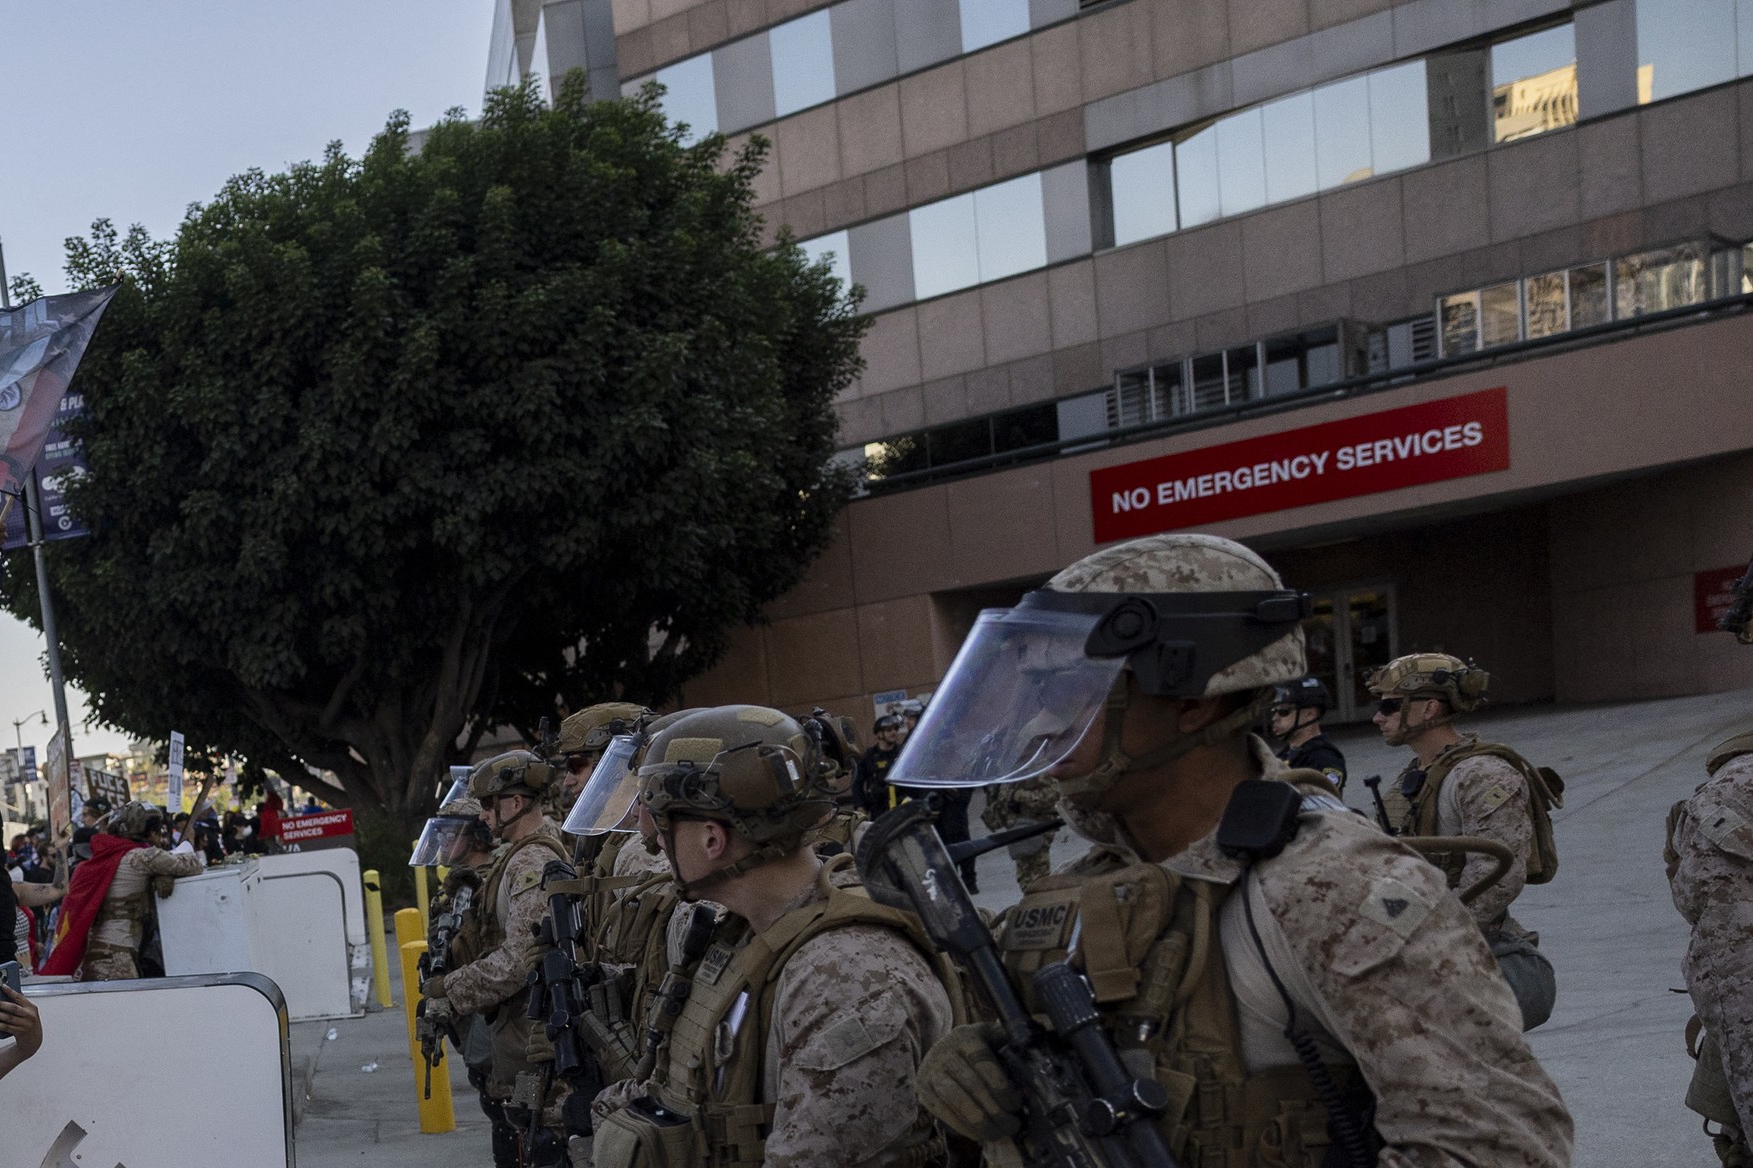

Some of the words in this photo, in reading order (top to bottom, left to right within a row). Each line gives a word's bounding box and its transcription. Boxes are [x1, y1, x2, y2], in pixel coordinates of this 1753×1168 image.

[68, 394, 84, 410] PLA
[1112, 486, 1151, 514] NO
[1157, 450, 1329, 506] EMERGENCY
[1337, 421, 1484, 471] SERVICES
[90, 769, 125, 793] FUCK
[282, 821, 295, 831] NO
[296, 814, 347, 829] EMERGENCY
[283, 827, 323, 841] SERVICES
[1014, 905, 1066, 928] USMC
